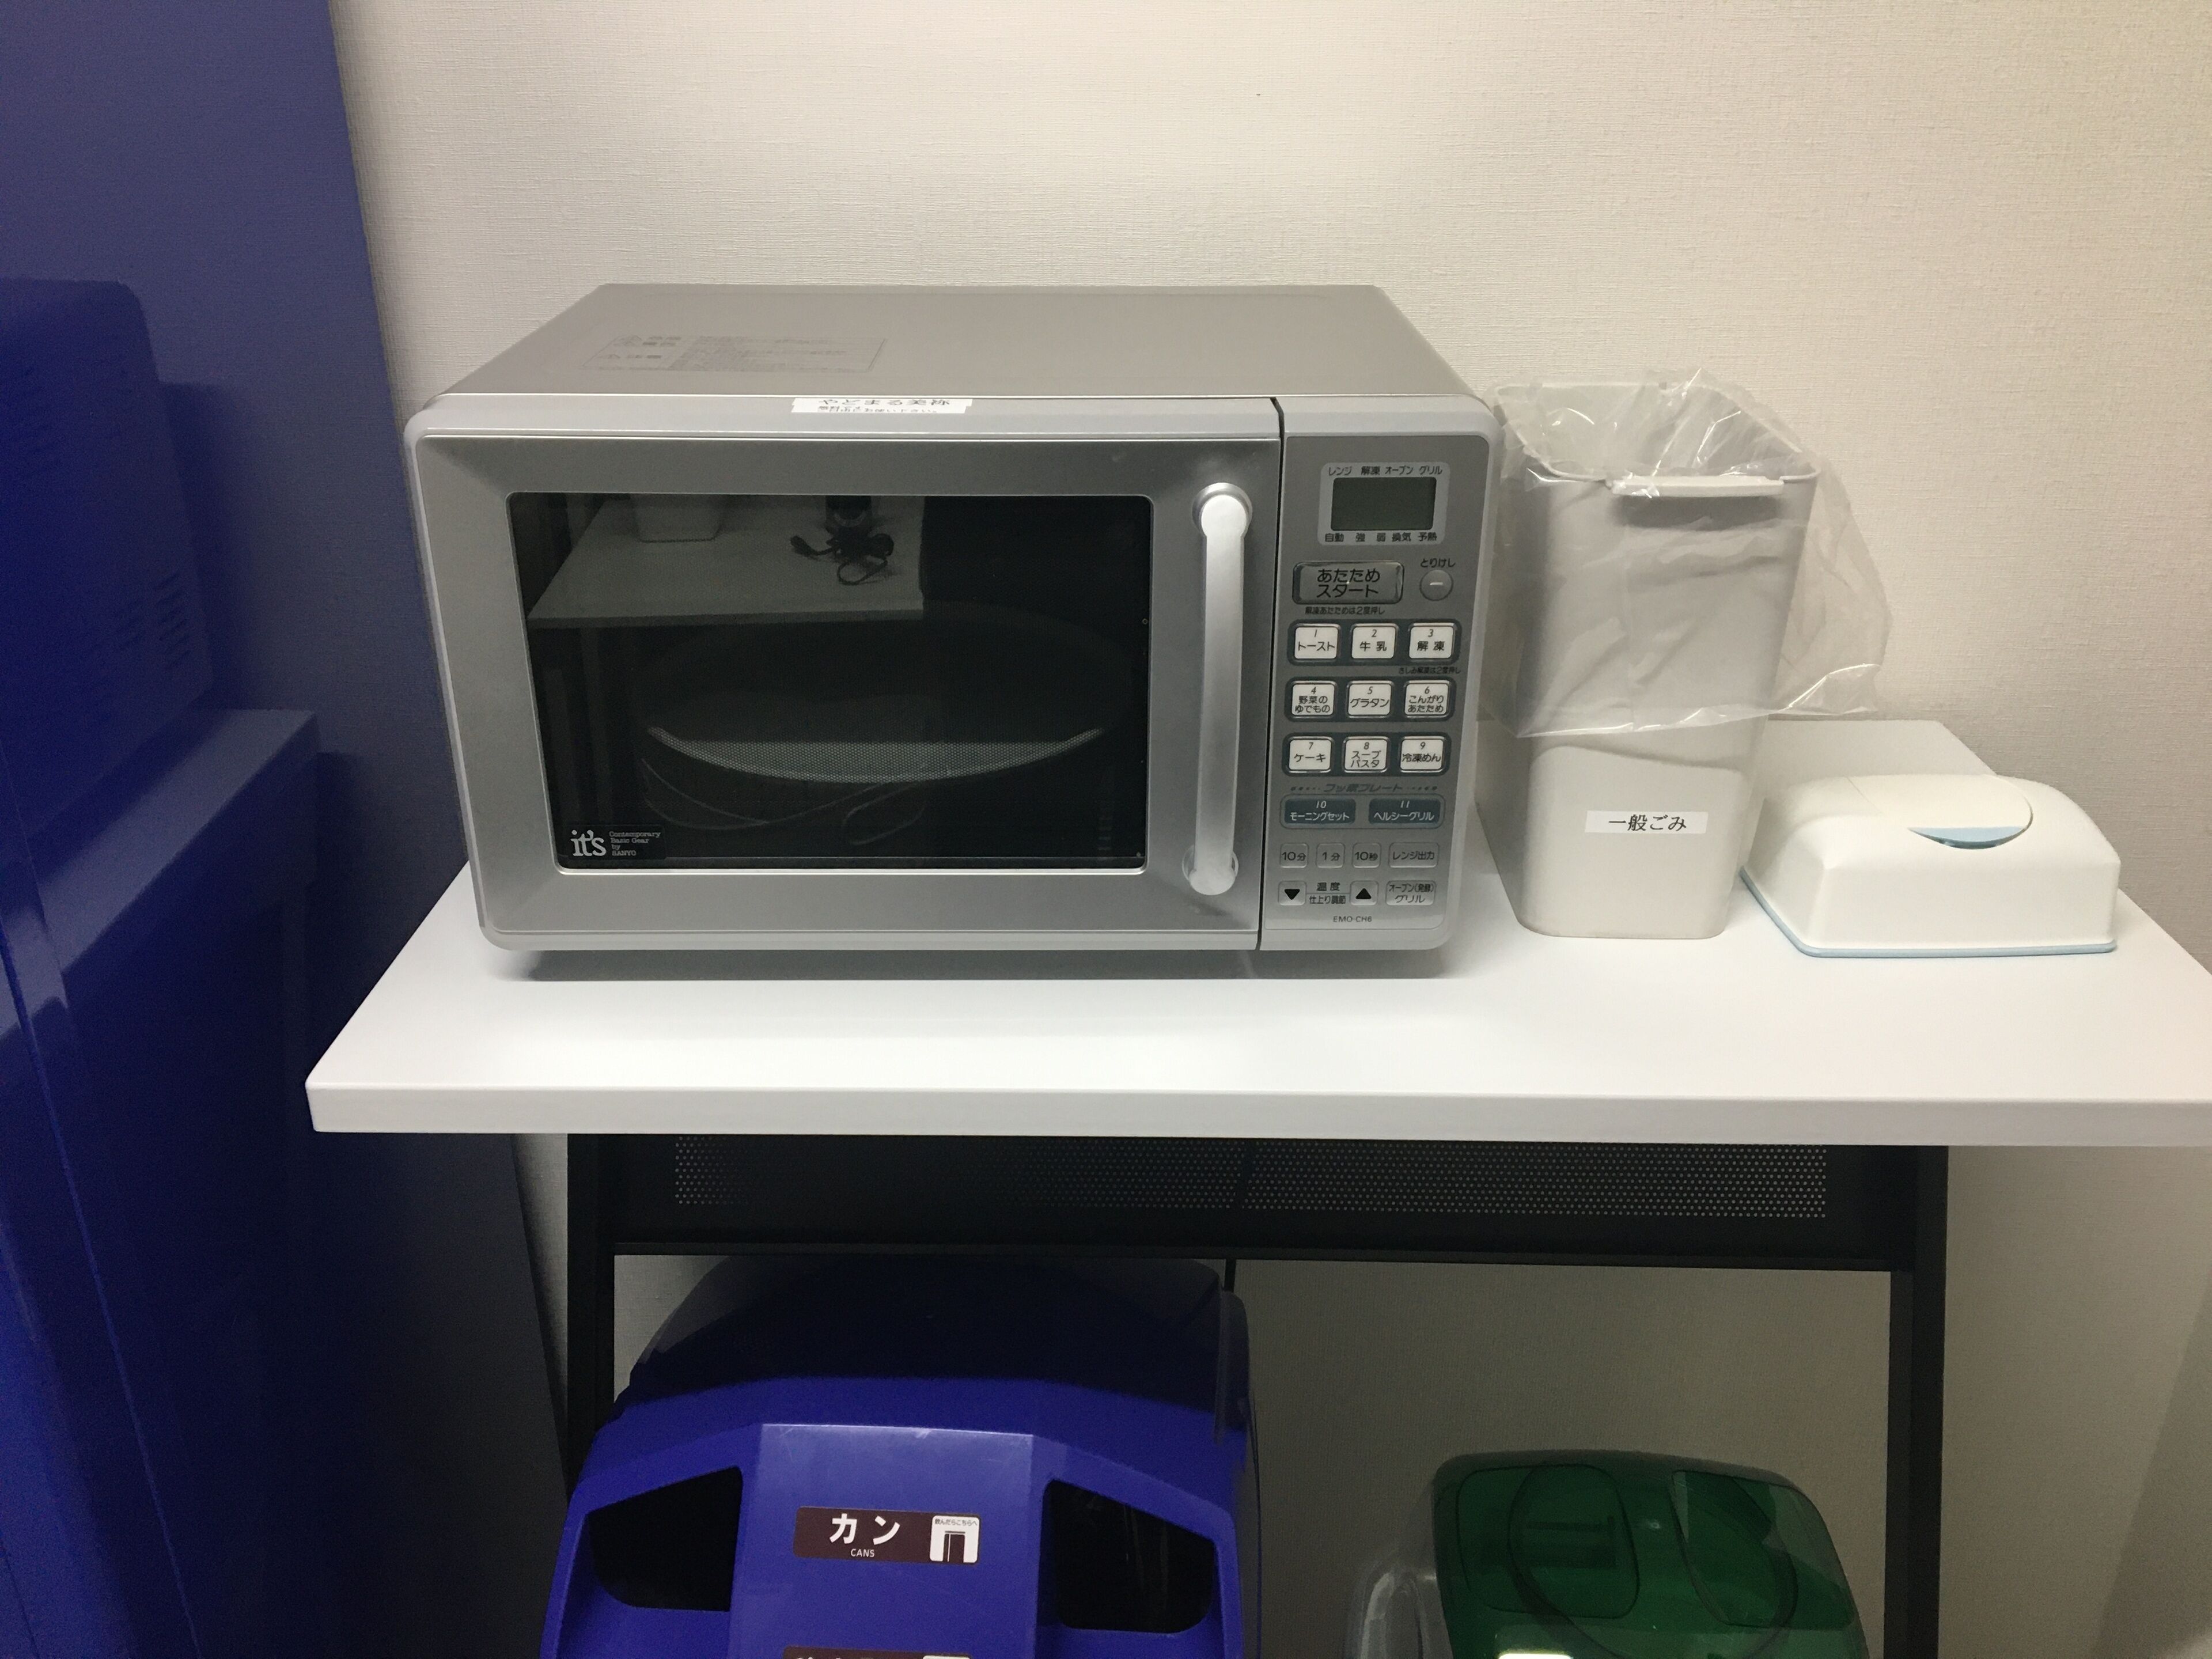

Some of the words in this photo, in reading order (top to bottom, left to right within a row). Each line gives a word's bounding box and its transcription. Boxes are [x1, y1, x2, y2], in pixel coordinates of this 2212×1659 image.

[1328, 465, 1352, 475] レンジ
[1361, 465, 1381, 475] 解凍
[1419, 464, 1442, 475] グリル
[1325, 532, 1344, 542] 自動
[1355, 533, 1365, 542] 強
[1377, 533, 1386, 542] 弱
[1392, 532, 1411, 542] 換気
[1418, 531, 1437, 541] 予熱
[1420, 557, 1456, 568] とりけし
[1317, 568, 1380, 583] あたため
[1317, 584, 1378, 599] スタート
[1371, 629, 1377, 638] 2
[1427, 628, 1434, 638] 3
[1298, 641, 1335, 652] トースト
[1359, 641, 1387, 652] 牛乳
[1416, 641, 1445, 652] 解凍
[1310, 687, 1317, 695] 4
[1367, 686, 1373, 695] 5
[1424, 686, 1430, 694] 6
[1298, 695, 1328, 704] 野菜の
[1350, 698, 1389, 708] グラタン
[1408, 695, 1444, 704] こんがり
[1295, 704, 1330, 714] ゆでもの
[1407, 704, 1444, 713] あたため
[1308, 742, 1314, 750] 7
[1363, 742, 1369, 750] 8
[1420, 741, 1426, 749] 9
[1294, 753, 1326, 763] ケーキ
[1351, 750, 1381, 759] スープ
[1402, 752, 1441, 763] 冷凍めん
[1350, 759, 1380, 768] パスタ
[1316, 800, 1327, 809] 10
[1400, 800, 1410, 808] 11
[1290, 811, 1350, 821] モーニングセット
[1373, 811, 1434, 821] ヘルシーグリル
[1608, 814, 1687, 832] 一般ごみ
[570, 830, 607, 857] it's
[1282, 851, 1306, 861] 10分
[1355, 851, 1378, 861] 10秒
[1392, 850, 1435, 861] レンジ出力
[1309, 895, 1346, 904] 仕上り調節
[1395, 894, 1425, 903] グリル
[934, 1518, 978, 1527] 飲んだらこちらへ
[829, 1513, 900, 1546] カン
[850, 1548, 875, 1558] CANS
